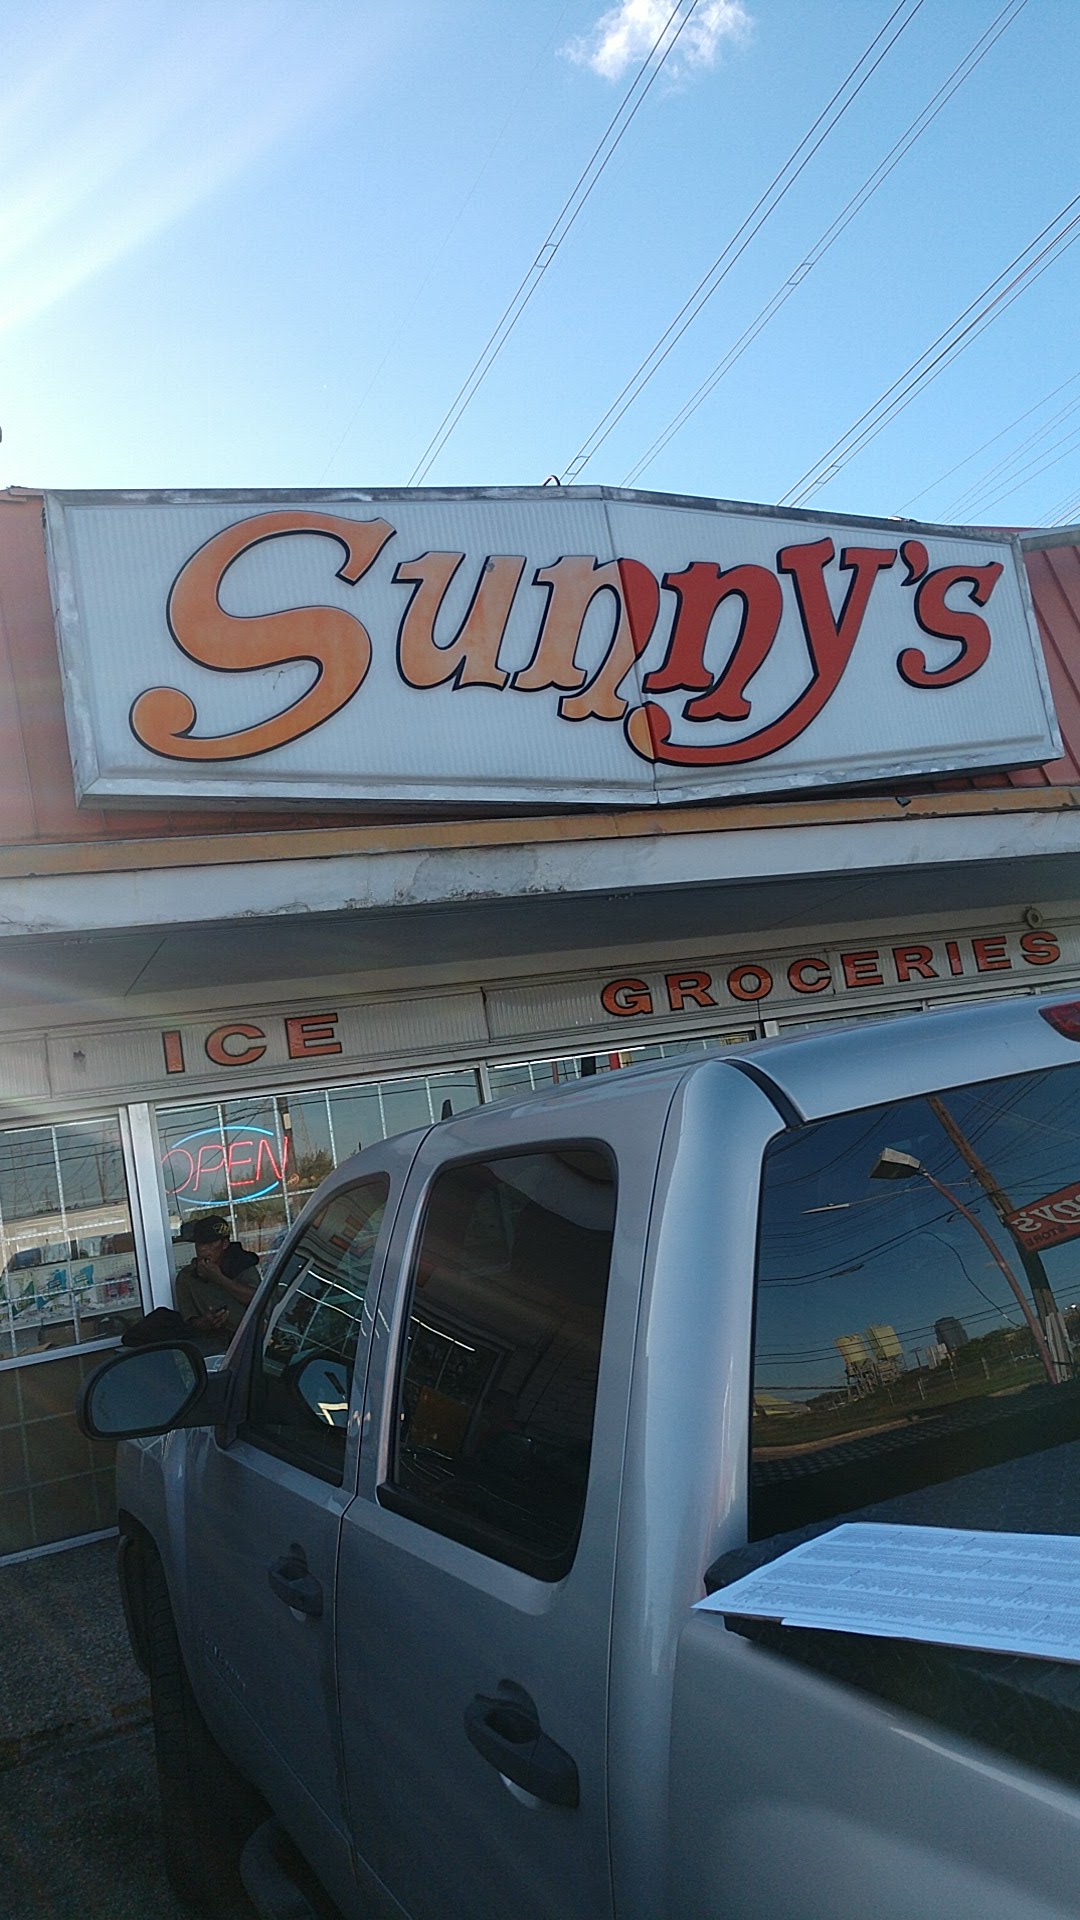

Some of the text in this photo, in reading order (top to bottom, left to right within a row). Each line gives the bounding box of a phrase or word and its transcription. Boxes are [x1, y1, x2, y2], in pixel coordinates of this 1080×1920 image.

[129, 509, 1004, 766] Sunny's
[601, 930, 1061, 1017] GROCERIES
[162, 1012, 343, 1075] ICE
[161, 1136, 289, 1194] OPEN
